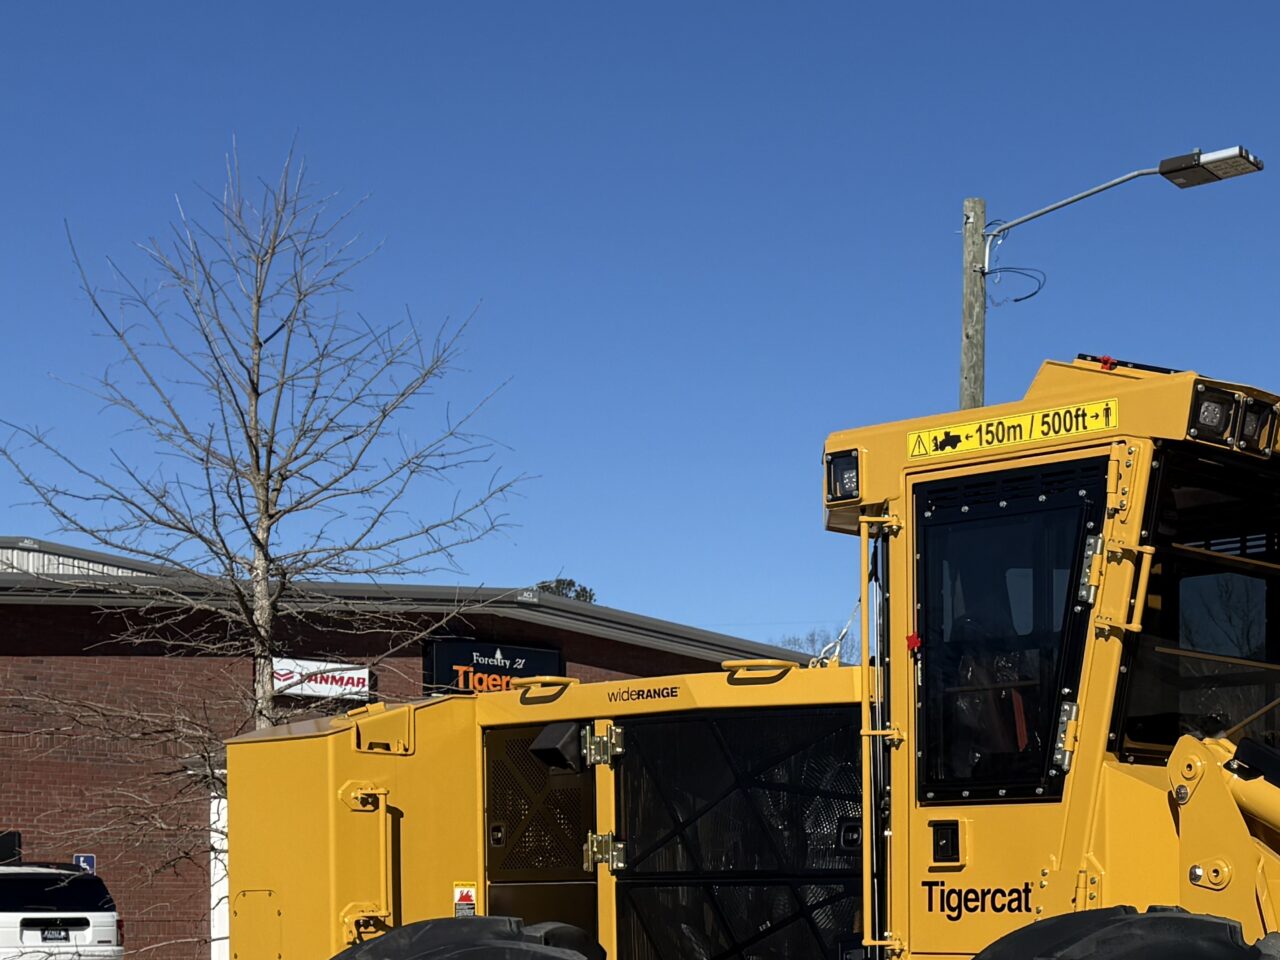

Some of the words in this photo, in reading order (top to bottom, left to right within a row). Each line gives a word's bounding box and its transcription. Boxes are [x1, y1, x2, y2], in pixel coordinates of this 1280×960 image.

[975, 421, 1022, 447] 150m
[1029, 415, 1034, 439] /
[1040, 407, 1087, 437] 500ft
[299, 671, 366, 688] ANMAR
[607, 686, 678, 702] wideRANGE
[921, 880, 1032, 922] Tigercat
